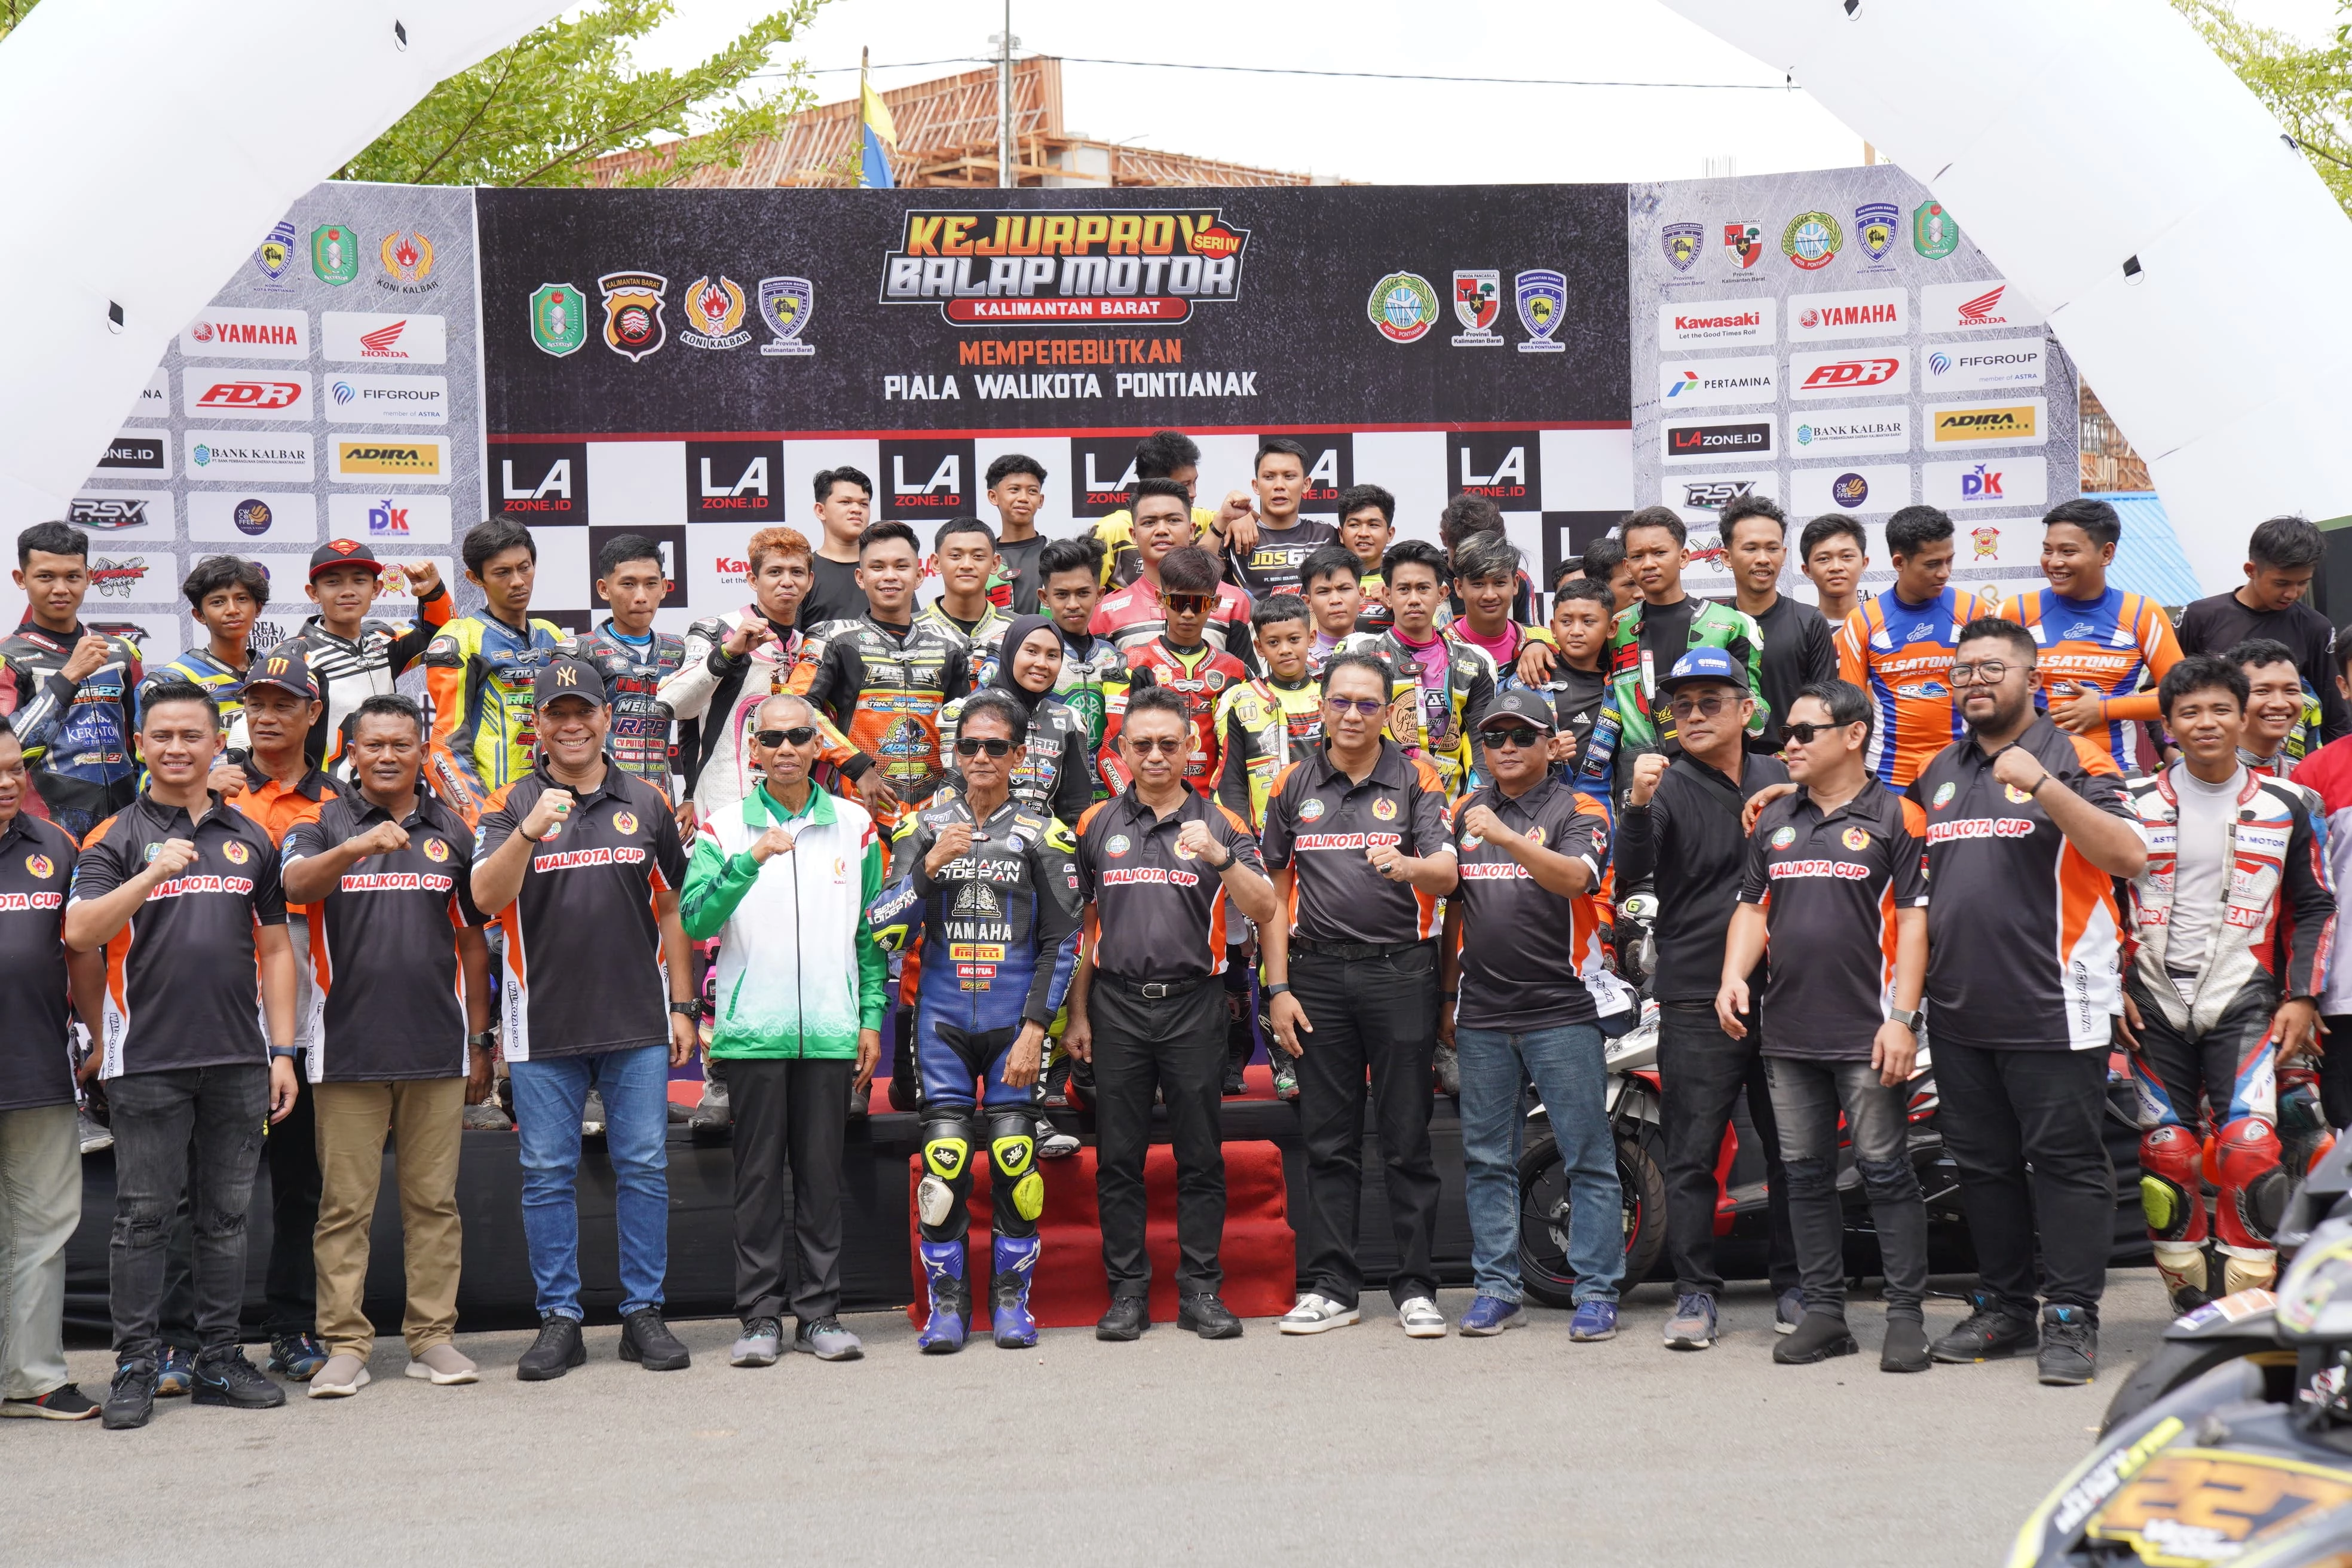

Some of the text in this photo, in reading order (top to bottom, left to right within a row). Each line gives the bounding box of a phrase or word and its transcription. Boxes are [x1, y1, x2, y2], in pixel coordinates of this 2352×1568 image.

[1194, 235, 1240, 250] SERI IV
[1807, 255, 1831, 268] PONTIANAK
[605, 278, 660, 289] KALIMANTAN BARAT
[888, 256, 1236, 296] BALAP MOTOR
[376, 278, 439, 294] KONI KALBAR
[975, 302, 1160, 316] KALIMANTAN BARAT
[1821, 304, 1897, 326] YAMAHA
[1675, 311, 1760, 330] Kawasaki
[1958, 317, 2007, 326] HONDA
[216, 323, 298, 345] YAMAHA
[1384, 324, 1424, 338] KOTA PONTIANAK
[682, 332, 751, 348] KONI KALBAR
[959, 339, 1181, 365] MEMPEREBUTKAN
[1960, 353, 2038, 367] FIFGROUP
[1803, 360, 1892, 384] FDR
[884, 371, 1257, 400] PIALA WALIKOTA PONTIANAK
[1704, 377, 1771, 389] PERTAMINA
[198, 384, 293, 406] FDR
[363, 390, 440, 400] FIFGROUP
[1941, 413, 2014, 427] ADIRA
[1814, 422, 1901, 436] BANK KALBAR
[1676, 431, 1762, 448] LA ZONE.ID
[212, 448, 305, 460] BANK KALBAR
[345, 448, 418, 460] ADIRA
[1460, 446, 1525, 485] LA
[502, 459, 571, 499] LA
[700, 457, 768, 496] LA
[893, 454, 960, 494] LA
[1462, 485, 1526, 497] ZONE.ID
[1962, 473, 2003, 495] DK
[504, 500, 571, 512] ZONE.ID
[702, 497, 768, 509] ZONE.ID
[895, 495, 960, 506] ZONE.ID
[369, 509, 409, 530] DK
[65, 722, 120, 743] KERATON
[1996, 819, 2032, 837] CUP
[1296, 833, 1399, 850] WALIKOTA CUP
[2248, 836, 2286, 848] MOTOR
[535, 847, 644, 871] WALIKOTA CUP
[1769, 861, 1867, 878] WALIKOTA CUP
[223, 875, 253, 893] CUP
[342, 874, 452, 890] WALIKOTA CUP
[1169, 871, 1197, 886] CUP
[32, 893, 62, 908] CUP
[874, 887, 915, 915] SEMAKIN
[944, 921, 1012, 941] YAMAHA
[954, 947, 1000, 958] PIRELLI
[507, 981, 518, 1027] WALIKOTA
